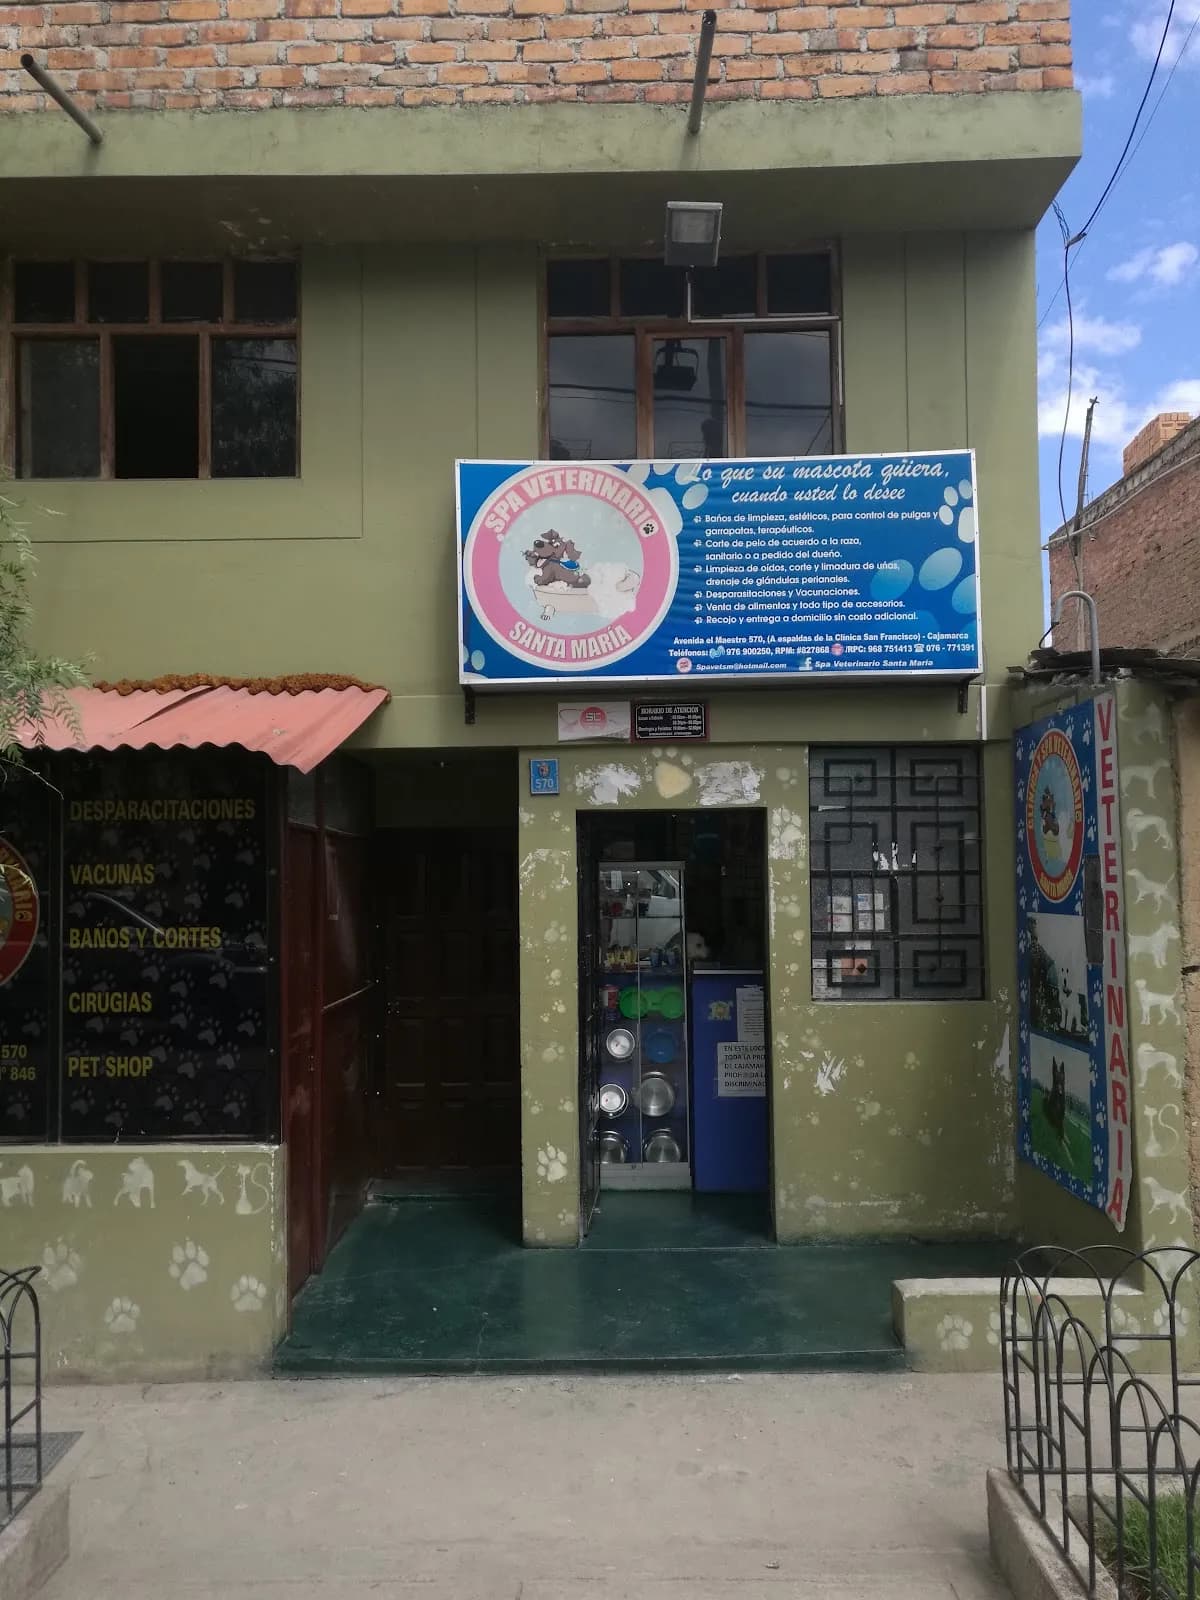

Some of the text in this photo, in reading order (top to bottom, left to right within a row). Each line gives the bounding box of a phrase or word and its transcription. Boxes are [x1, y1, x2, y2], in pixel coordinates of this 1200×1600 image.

[721, 467, 754, 488] que
[763, 466, 784, 480] su
[793, 461, 873, 479] mascota
[881, 459, 950, 485] qüiera,
[732, 483, 906, 503] cuando usted lo desee
[484, 469, 660, 542] SPA VETERINARIO
[705, 510, 939, 523] Baños de limpieza, estéticos, para control de pulgas y
[705, 525, 815, 537] garrapatas, terapéuticos.
[706, 537, 862, 549] Corte de pelo de acuerdo a la raza,
[705, 549, 843, 561] sanitario o a pedido del dueño.
[705, 564, 745, 574] Limpieza
[746, 564, 759, 572] de
[760, 563, 787, 573] oídos,
[788, 563, 812, 572] corte
[814, 563, 820, 572] y
[821, 562, 861, 571] limadura
[862, 561, 875, 570] de
[705, 575, 850, 587] drenaje de glándulas perianales.
[705, 587, 861, 600] Desparasitaciones y Vacunaciones.
[706, 599, 906, 611] Venta de alimentos y todo tipo de accesorios.
[706, 615, 737, 625] Recojo
[738, 616, 744, 625] y
[746, 615, 781, 625] entrega
[791, 613, 832, 622] domicilio
[834, 613, 846, 621] sin
[847, 612, 872, 621] costo
[874, 611, 919, 621] adicional.
[508, 620, 633, 660] SANTA MARÍA
[673, 636, 705, 645] Avenida
[706, 635, 714, 644] el
[715, 635, 747, 645] Maestro
[748, 635, 766, 645] 570,
[767, 634, 776, 644] (A
[777, 634, 812, 644] espaldas
[814, 633, 824, 642] de
[825, 633, 833, 642] la
[863, 632, 879, 641] San
[880, 632, 921, 642] Francisco)
[927, 631, 969, 642] Cajamarca
[669, 648, 708, 657] Teléfonos:
[726, 647, 740, 656] 976
[742, 646, 773, 657] 900250,
[774, 646, 795, 655] RPM:
[796, 646, 830, 655] #827868
[868, 644, 882, 653] 968
[884, 644, 913, 653] 751413
[926, 644, 941, 653] 076
[946, 643, 976, 652] 771391
[815, 658, 934, 669] Spa Veterinario Santa María
[535, 778, 554, 789] 570
[69, 799, 256, 821] DESPARACITACIONES
[69, 863, 155, 885] VACUNAS
[136, 927, 147, 948] Y
[153, 926, 222, 949] CORTES
[1096, 698, 1128, 1223] VETERINARIA
[68, 991, 152, 1013] CIRUGIAS
[1, 1044, 28, 1059] 570
[67, 1055, 153, 1078] PET SHOP
[10, 1066, 37, 1082] 846
